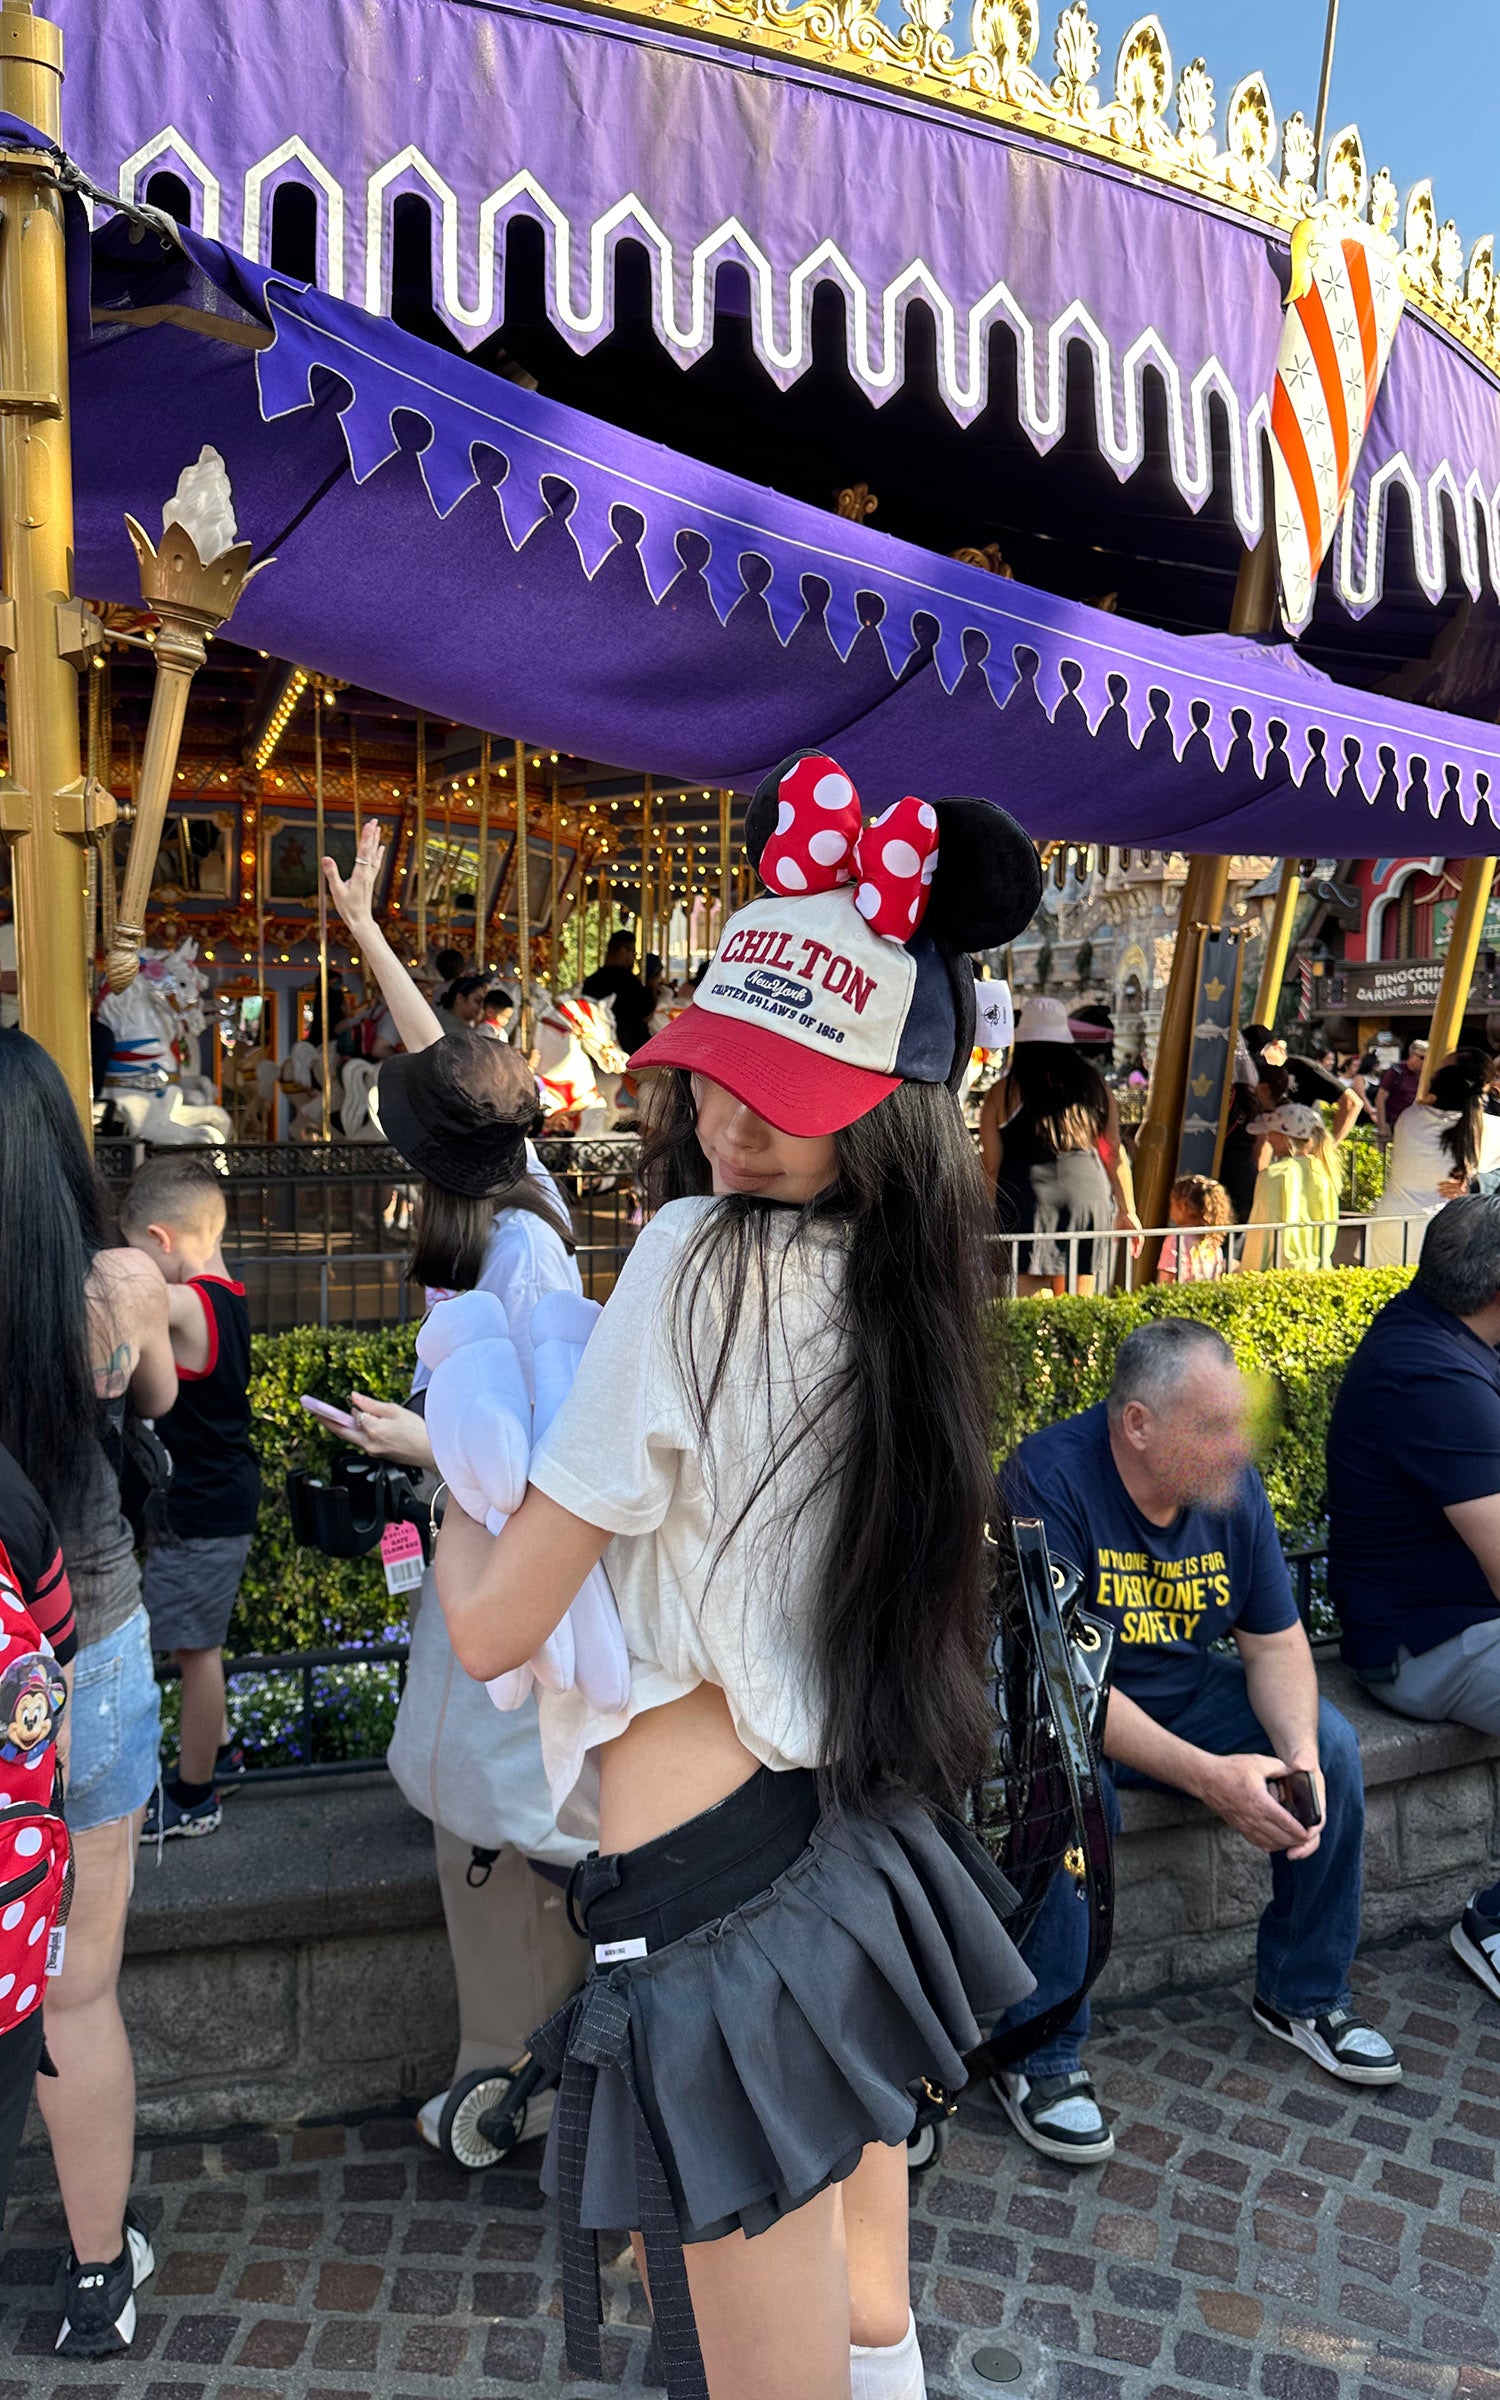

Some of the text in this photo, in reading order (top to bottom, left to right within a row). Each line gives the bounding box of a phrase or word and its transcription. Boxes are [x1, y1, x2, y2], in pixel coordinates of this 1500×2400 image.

[720, 929, 878, 1015] CHILTON
[799, 1013, 817, 1029] OF
[1115, 1551, 1150, 1571] LONE
[1152, 1560, 1184, 1579] TIME
[1185, 1556, 1199, 1575] IS
[1200, 1551, 1226, 1574] FOR
[1096, 1572, 1231, 1611] EVERYONE'S
[1120, 1611, 1200, 1645] SAFETY
